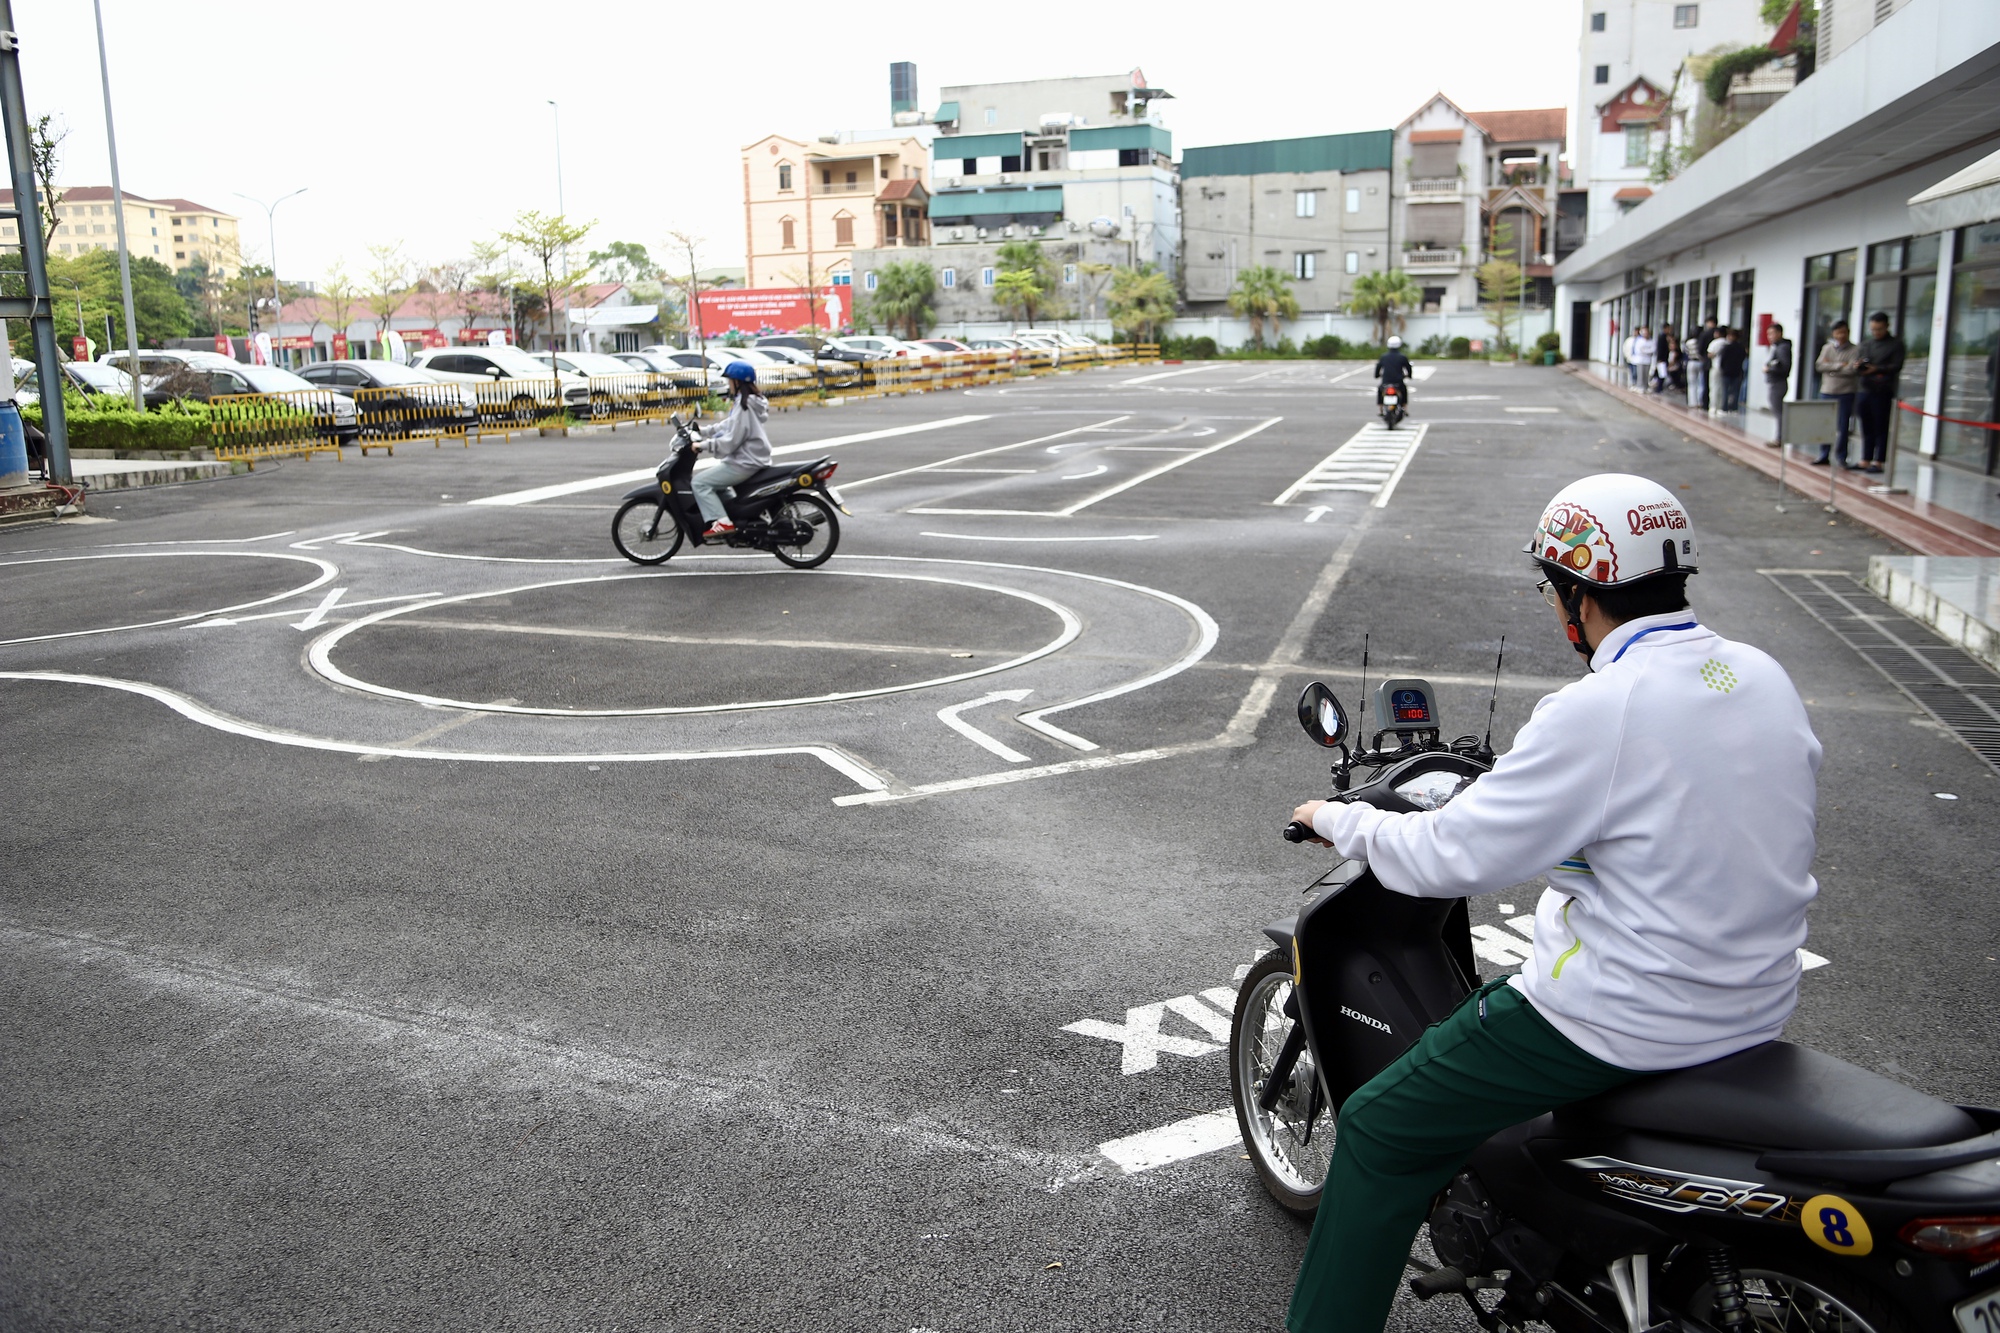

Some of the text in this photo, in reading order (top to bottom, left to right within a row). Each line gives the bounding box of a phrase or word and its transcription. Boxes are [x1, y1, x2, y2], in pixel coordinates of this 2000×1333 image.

[1340, 1005, 1393, 1035] HONDA
[1598, 1172, 1669, 1195] WAVE
[1819, 1207, 1854, 1247] 8
